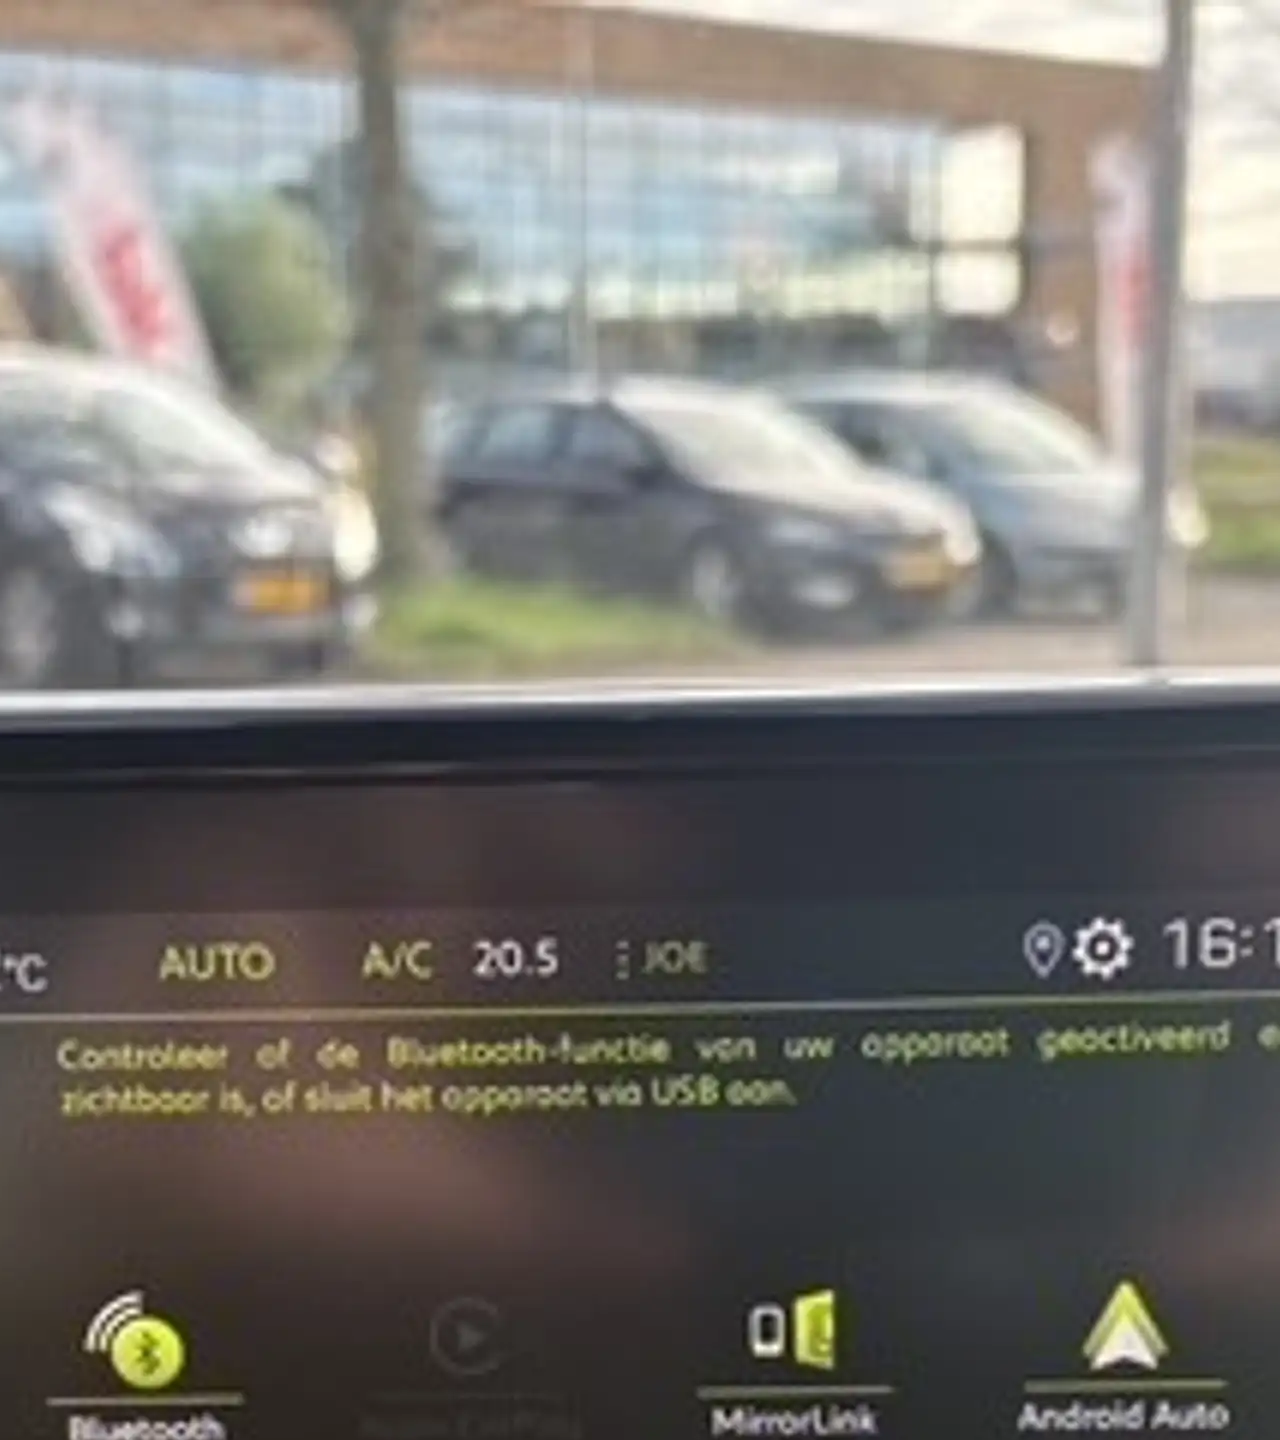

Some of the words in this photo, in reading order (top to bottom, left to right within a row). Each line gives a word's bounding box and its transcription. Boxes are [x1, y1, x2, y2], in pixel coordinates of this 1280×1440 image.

[158, 943, 277, 982] AUTO
[361, 941, 433, 979] A/C
[472, 939, 560, 978] 20.5
[56, 1037, 228, 1072] Controleer
[255, 1036, 291, 1071] of
[316, 1035, 360, 1070] de
[694, 1035, 757, 1063] van
[784, 1033, 834, 1060] uw
[861, 1027, 1011, 1065] apparaat
[1036, 1020, 1232, 1061] geactiveerd
[61, 1082, 212, 1117] zichtbaar
[261, 1079, 297, 1113] of
[303, 1079, 374, 1113] sluit
[381, 1079, 433, 1112] het
[442, 1080, 589, 1116] apparaat
[594, 1078, 643, 1107] via
[650, 1074, 721, 1106] USB
[711, 1405, 878, 1437] MirrorLink
[1019, 1398, 1144, 1433] Android
[1150, 1401, 1231, 1431] Auto
